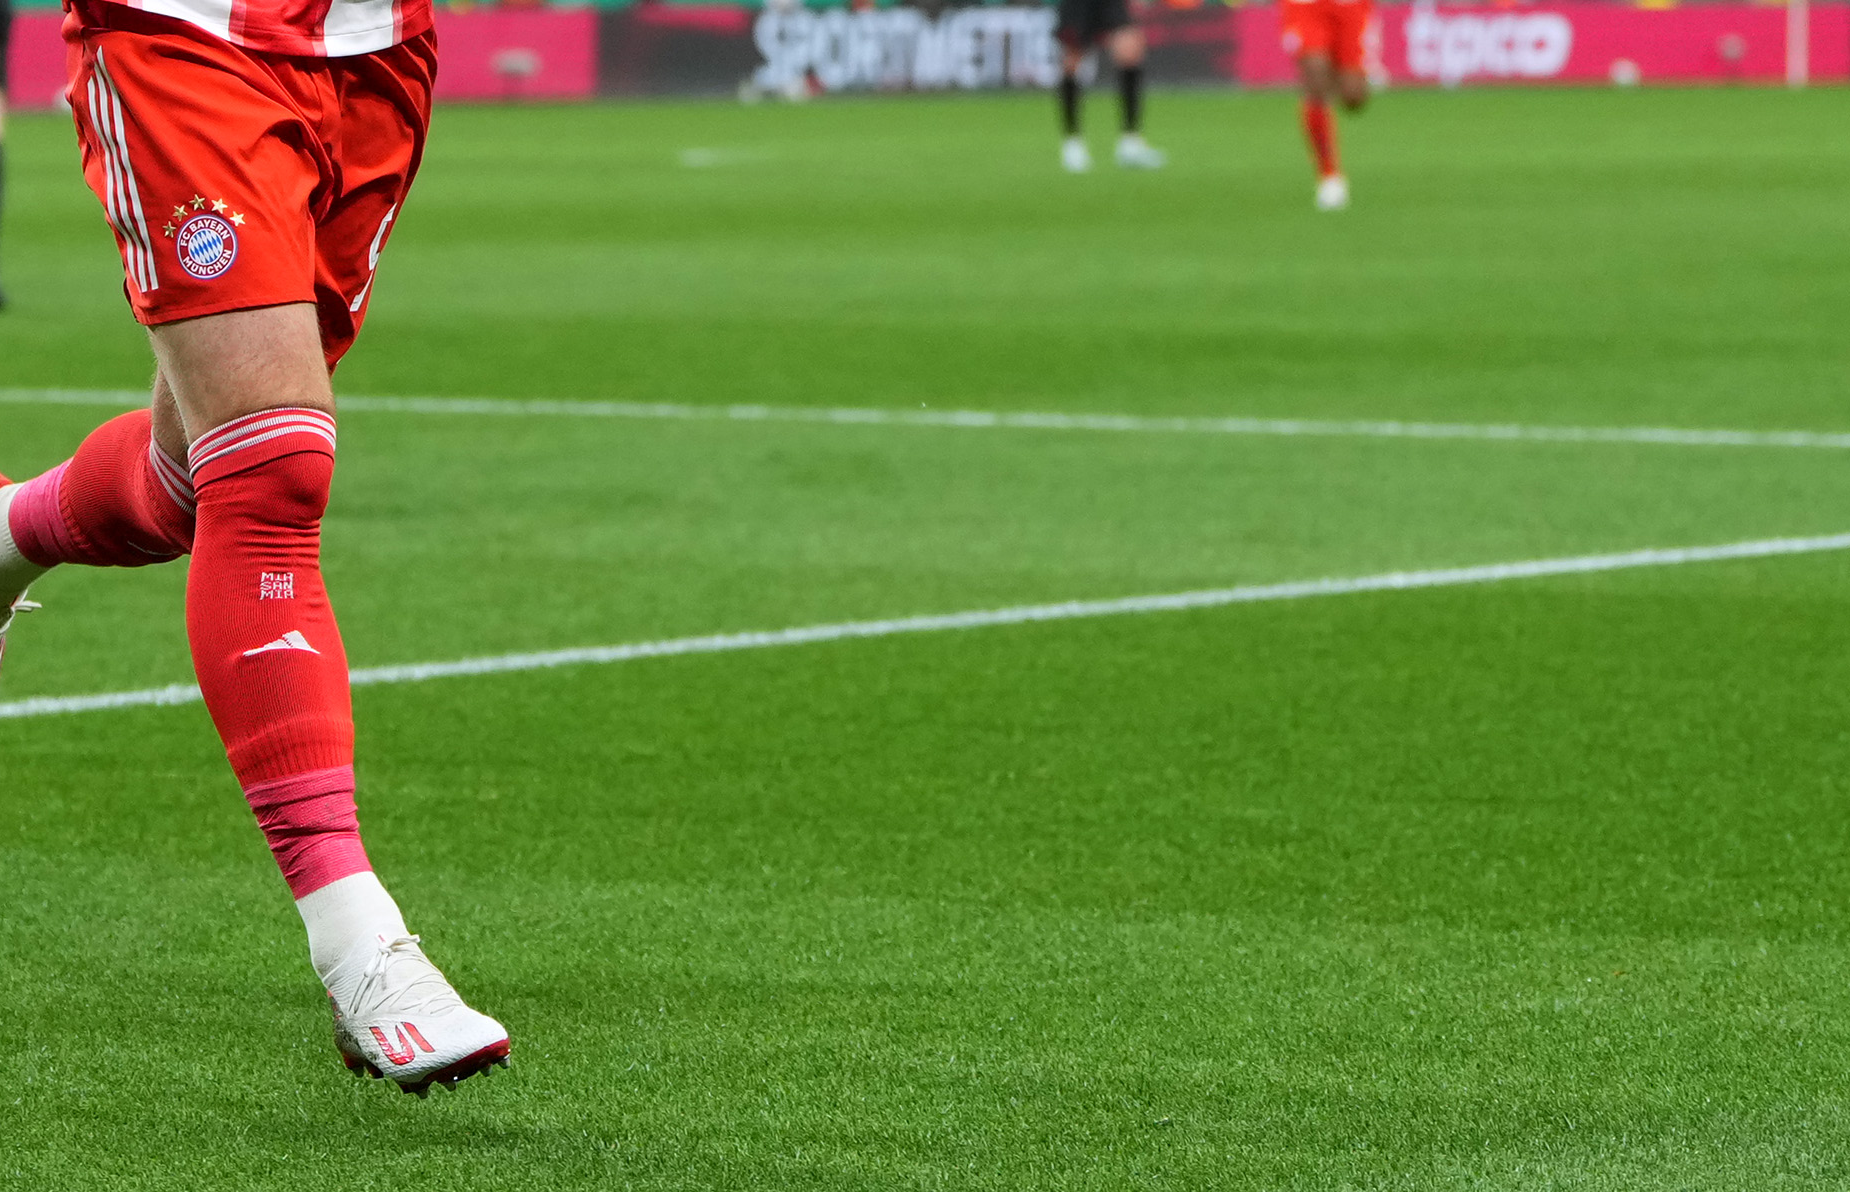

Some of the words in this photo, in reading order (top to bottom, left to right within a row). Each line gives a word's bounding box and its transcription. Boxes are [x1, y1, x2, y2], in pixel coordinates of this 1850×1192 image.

[180, 231, 191, 247] FC
[188, 219, 231, 240] BAYERN
[259, 581, 293, 590] SAN
[259, 589, 294, 600] MIA
